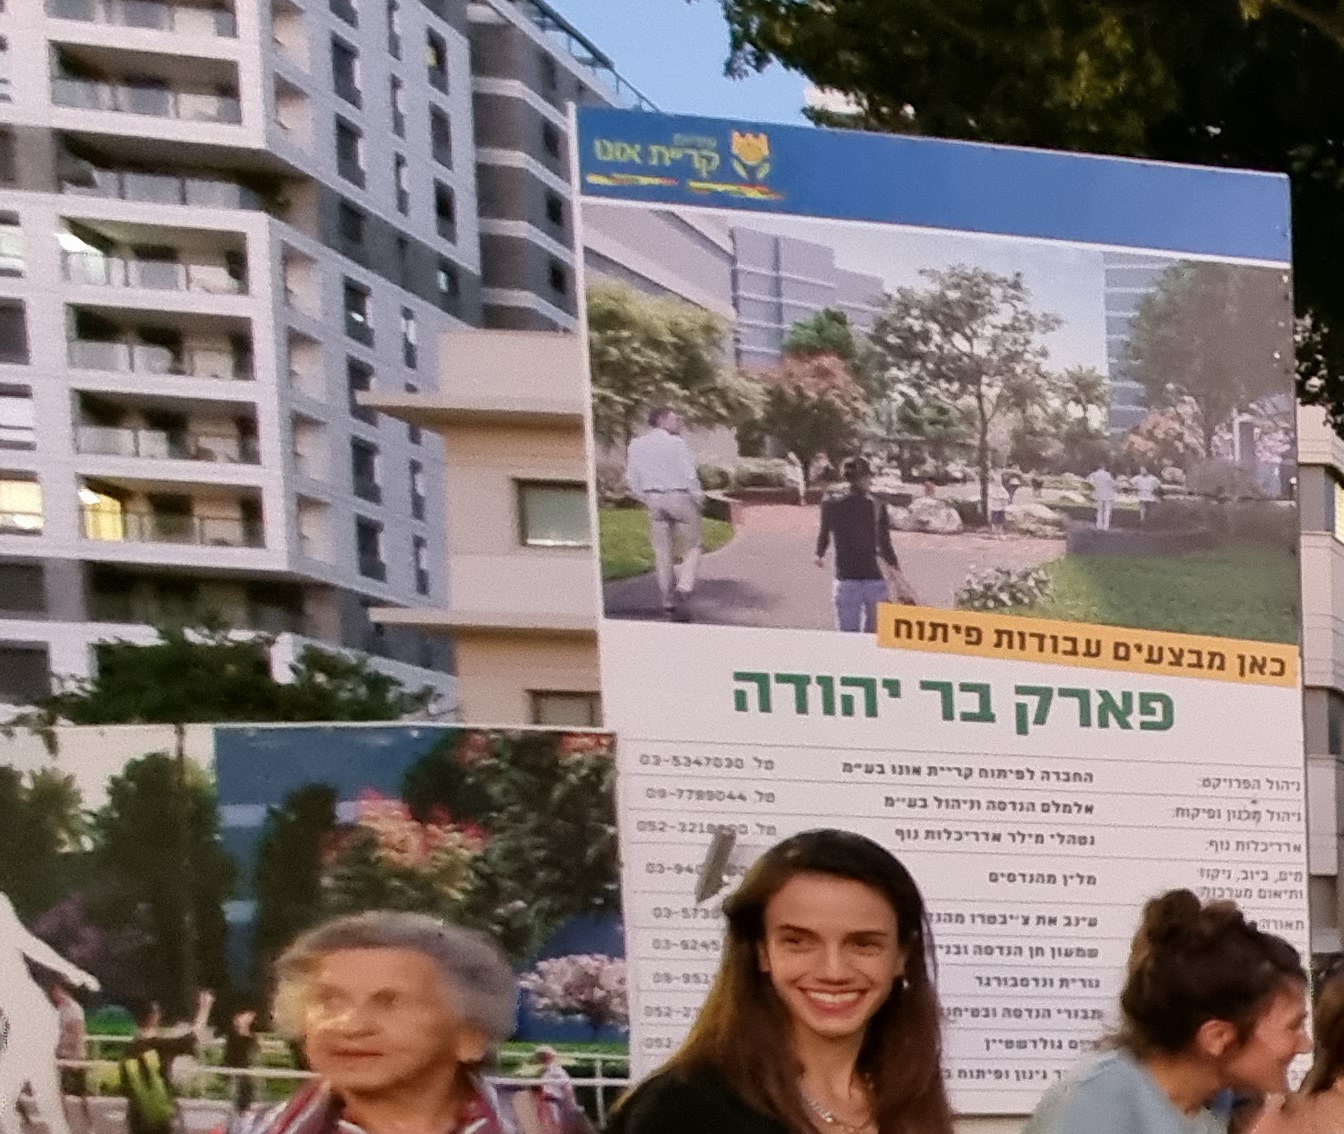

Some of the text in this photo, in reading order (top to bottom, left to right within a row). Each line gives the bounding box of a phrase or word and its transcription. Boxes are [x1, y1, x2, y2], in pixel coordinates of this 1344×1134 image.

[648, 144, 720, 178] קריית
[893, 617, 1287, 677] כאן מבצעים עבודות פיתוח
[733, 671, 1175, 736] פארק בר יהודה
[891, 763, 922, 776] אונו
[926, 765, 973, 781] קריית
[978, 767, 1035, 781] לפיתוח
[1040, 770, 1094, 783] החברה
[1201, 776, 1301, 791] ניהול הפרויקט
[985, 798, 1036, 813] הנדסה
[1040, 799, 1095, 814] אלמלם
[1174, 807, 1222, 820] ופיקוח
[895, 827, 919, 842] נוף
[924, 828, 1003, 844] אדריכלות
[1007, 831, 1044, 845] מילר
[1208, 838, 1302, 853] אדריכלות נוף
[988, 870, 1058, 886] מהנדסים
[1257, 888, 1303, 900] ותיאום
[1035, 914, 1058, 927] את
[972, 944, 1023, 957] הנדסה
[1028, 945, 1045, 959] חן
[1051, 946, 1099, 960] שמעון
[1058, 977, 1100, 989] נורית
[1001, 1007, 1052, 1019] הנדסה
[984, 1037, 1063, 1051] גולדשטיין
[957, 1068, 1010, 1081] ופיתוח
[1014, 1068, 1048, 1082] גינון
